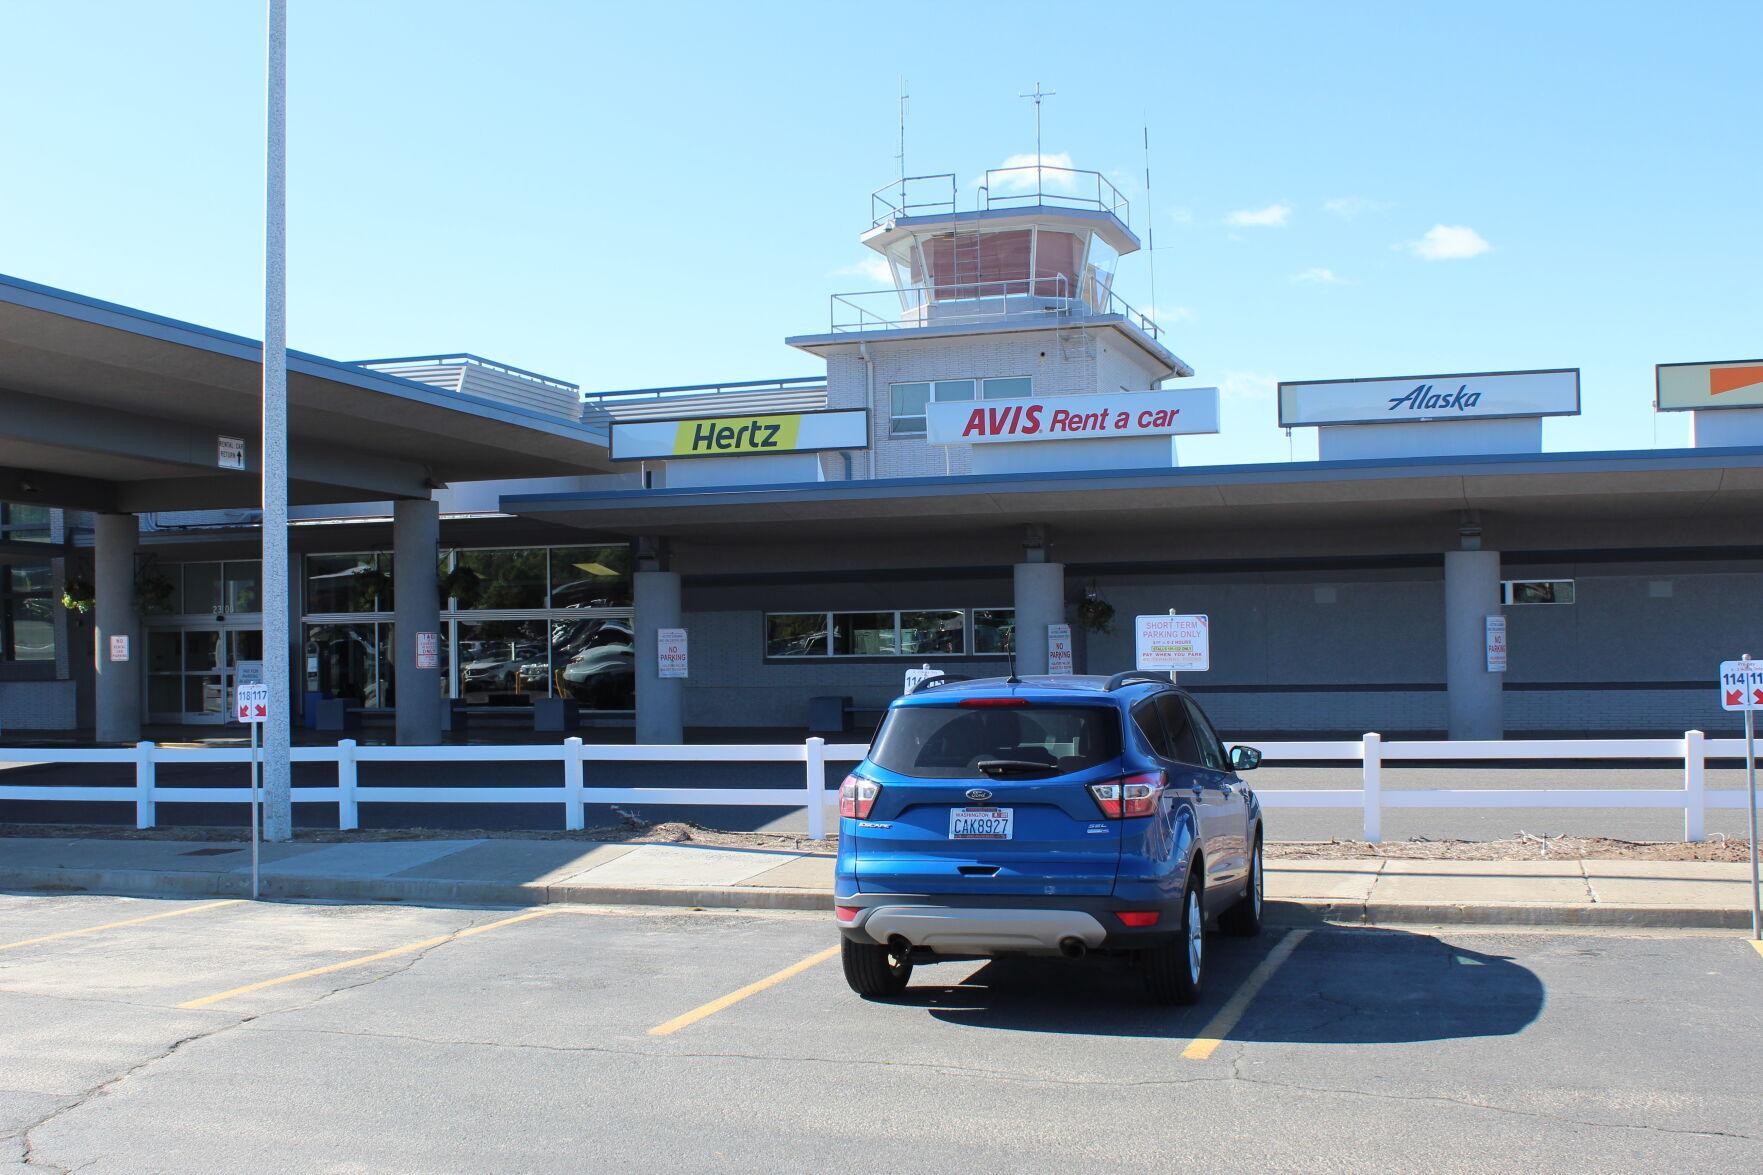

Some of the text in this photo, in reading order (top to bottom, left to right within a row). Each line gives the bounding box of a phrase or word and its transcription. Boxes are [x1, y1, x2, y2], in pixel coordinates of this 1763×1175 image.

[1388, 384, 1482, 411] Alaska
[962, 405, 1180, 437] AVIS Rent a car
[692, 420, 780, 450] Hertz
[1146, 621, 1198, 629] SHORT TERM
[1143, 630, 1201, 638] PARKING ONLY
[1056, 642, 1064, 650] NO
[1050, 651, 1071, 659] PARKING
[1723, 673, 1745, 685] 114
[1750, 672, 1763, 685] 11
[239, 691, 250, 700] 118
[253, 690, 267, 700] 117
[954, 819, 1008, 834] CAK8927
